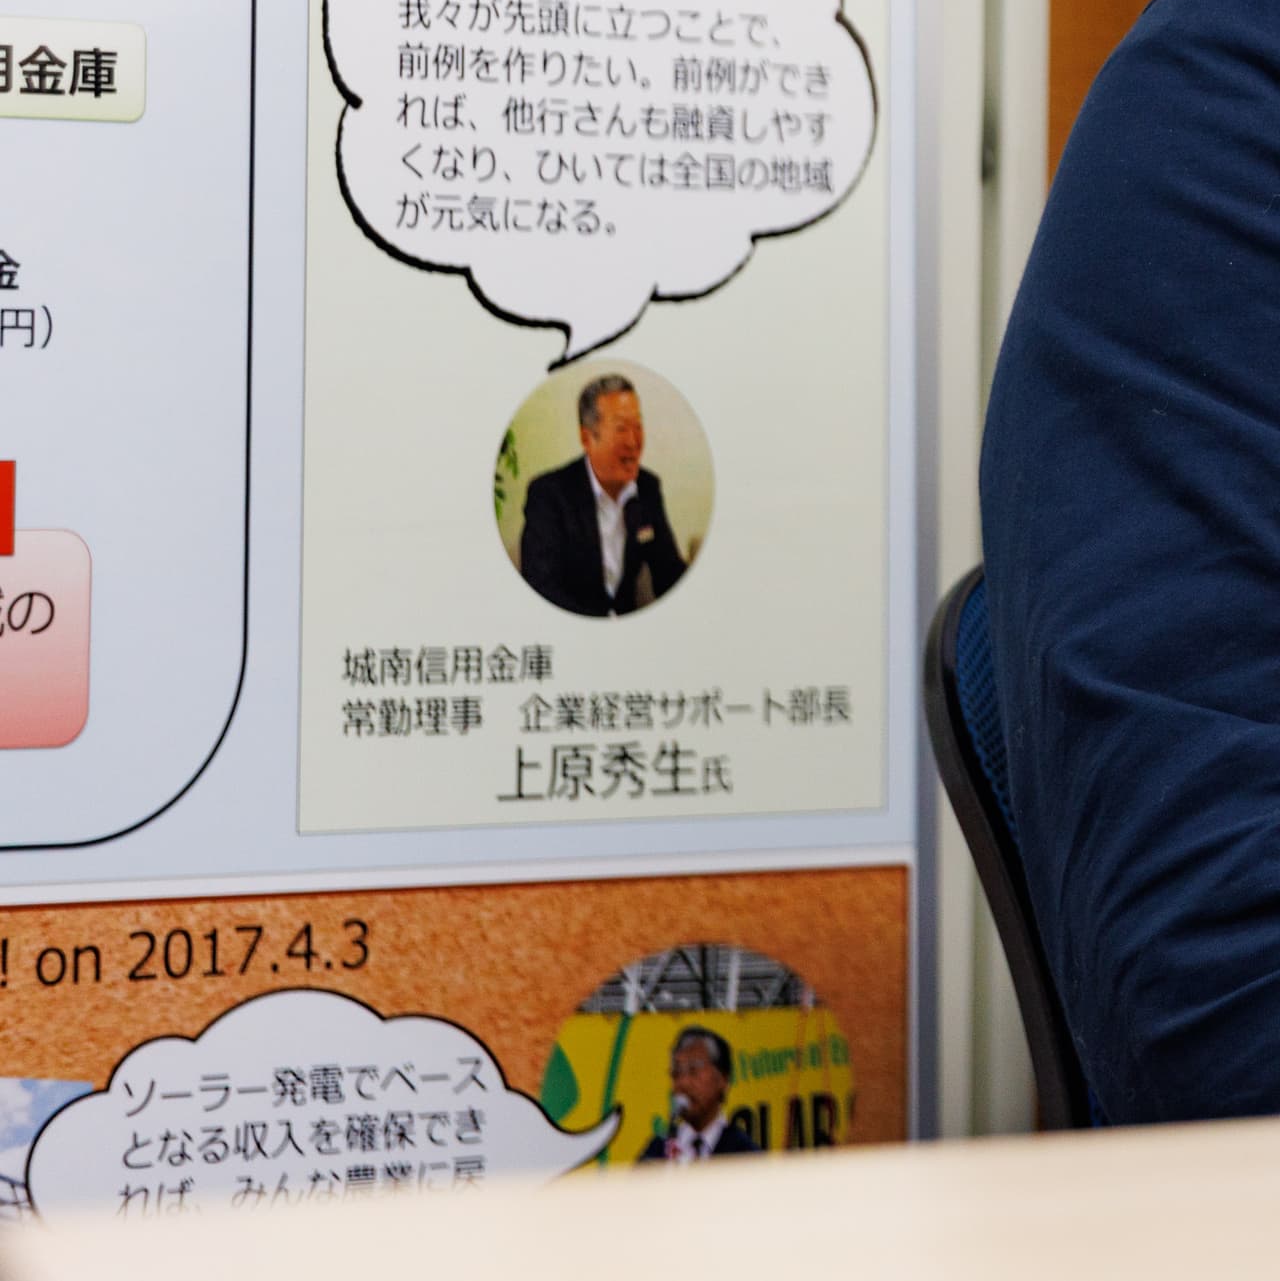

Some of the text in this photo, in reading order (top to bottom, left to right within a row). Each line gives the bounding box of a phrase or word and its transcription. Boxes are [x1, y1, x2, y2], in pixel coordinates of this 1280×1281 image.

[397, 41, 832, 98] 前例を作りたい。前例ができ
[396, 92, 832, 147] れば、他行さんも融資しやす
[400, 143, 835, 197] くなり、ひいては全国の地域
[395, 192, 618, 238] が元気になる。
[342, 644, 555, 687] 城南信用金庫
[341, 685, 853, 738] 常勤理事 企業経営サポート部長
[496, 739, 735, 803] 上原秀生氏
[36, 944, 101, 987] on
[127, 919, 371, 983] 2017.4.3
[122, 1055, 489, 1118] ソーラー発電でベース
[121, 1107, 487, 1171] となる収入を確保でき
